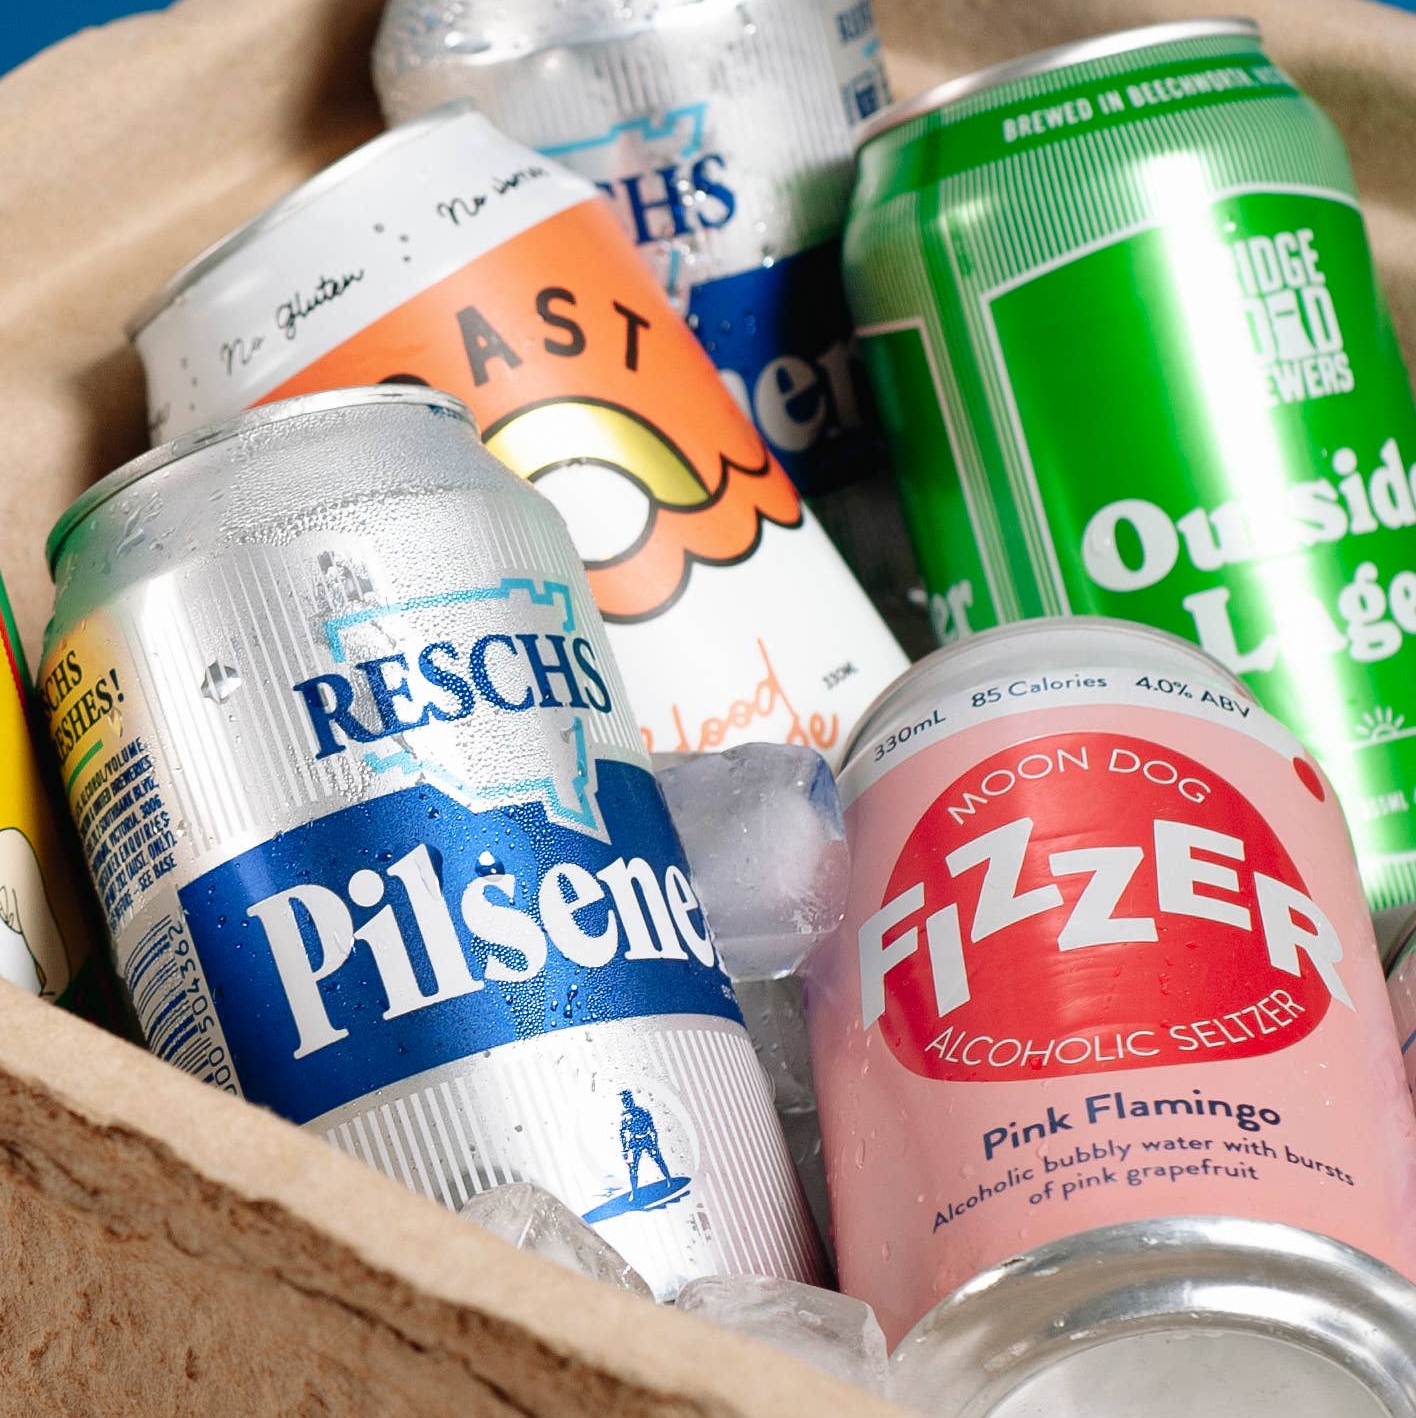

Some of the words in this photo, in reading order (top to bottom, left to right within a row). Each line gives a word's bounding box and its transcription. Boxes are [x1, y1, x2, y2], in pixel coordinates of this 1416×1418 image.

[1003, 97, 1093, 142] BREWED
[1098, 90, 1125, 114] IN
[594, 153, 736, 248] HS
[1234, 228, 1326, 298] IDGE
[384, 286, 651, 388] AST
[1082, 438, 1416, 592] Ousid
[293, 634, 612, 760] RESCHS
[874, 709, 947, 762] 330mL
[971, 687, 1002, 708] 85
[1008, 674, 1107, 697] Calories
[1135, 677, 1193, 699] 4.0%
[1201, 690, 1251, 719] ABV
[947, 746, 1090, 825] MOON
[1109, 749, 1212, 804] DOG
[246, 843, 730, 1059] Pilsene
[858, 817, 1356, 1031] FIZZER
[925, 1026, 1160, 1067] ALCOHOLIC
[1170, 989, 1305, 1051] SELTZER
[984, 1107, 1073, 1161] Pink
[1086, 1089, 1282, 1132] Flamingo
[932, 1168, 1035, 1234] Alcoholic
[1044, 1140, 1131, 1173] bubbly
[1142, 1136, 1213, 1152] water
[1223, 1137, 1278, 1159] with
[1285, 1145, 1355, 1186] bursts
[1029, 1180, 1055, 1205] of
[1062, 1165, 1118, 1200] pink
[1127, 1158, 1259, 1186] grapefruit
